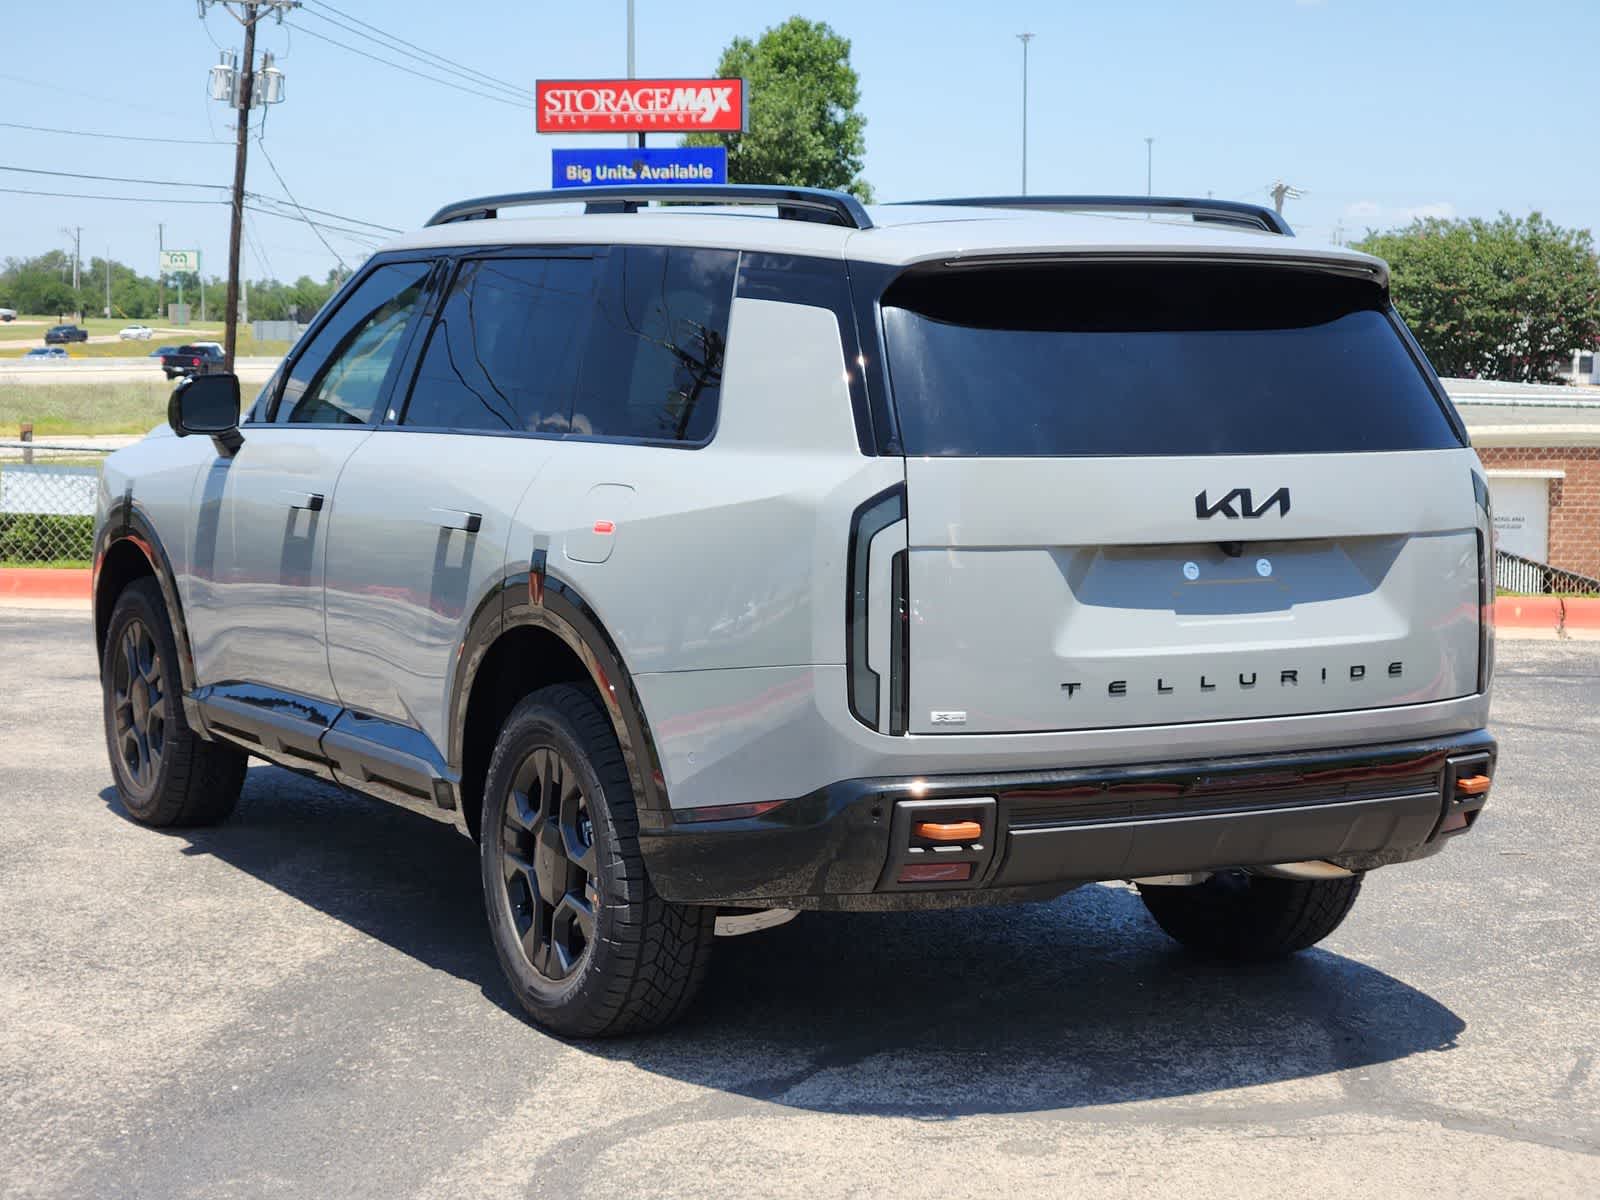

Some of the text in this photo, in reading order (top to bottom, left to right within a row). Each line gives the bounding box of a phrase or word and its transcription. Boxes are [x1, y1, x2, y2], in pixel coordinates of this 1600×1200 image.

[544, 87, 732, 122] STORAGEMAX
[610, 113, 698, 123] STORAGE
[566, 164, 713, 183] Big Units Available
[1061, 662, 1403, 698] TELLURIDE
